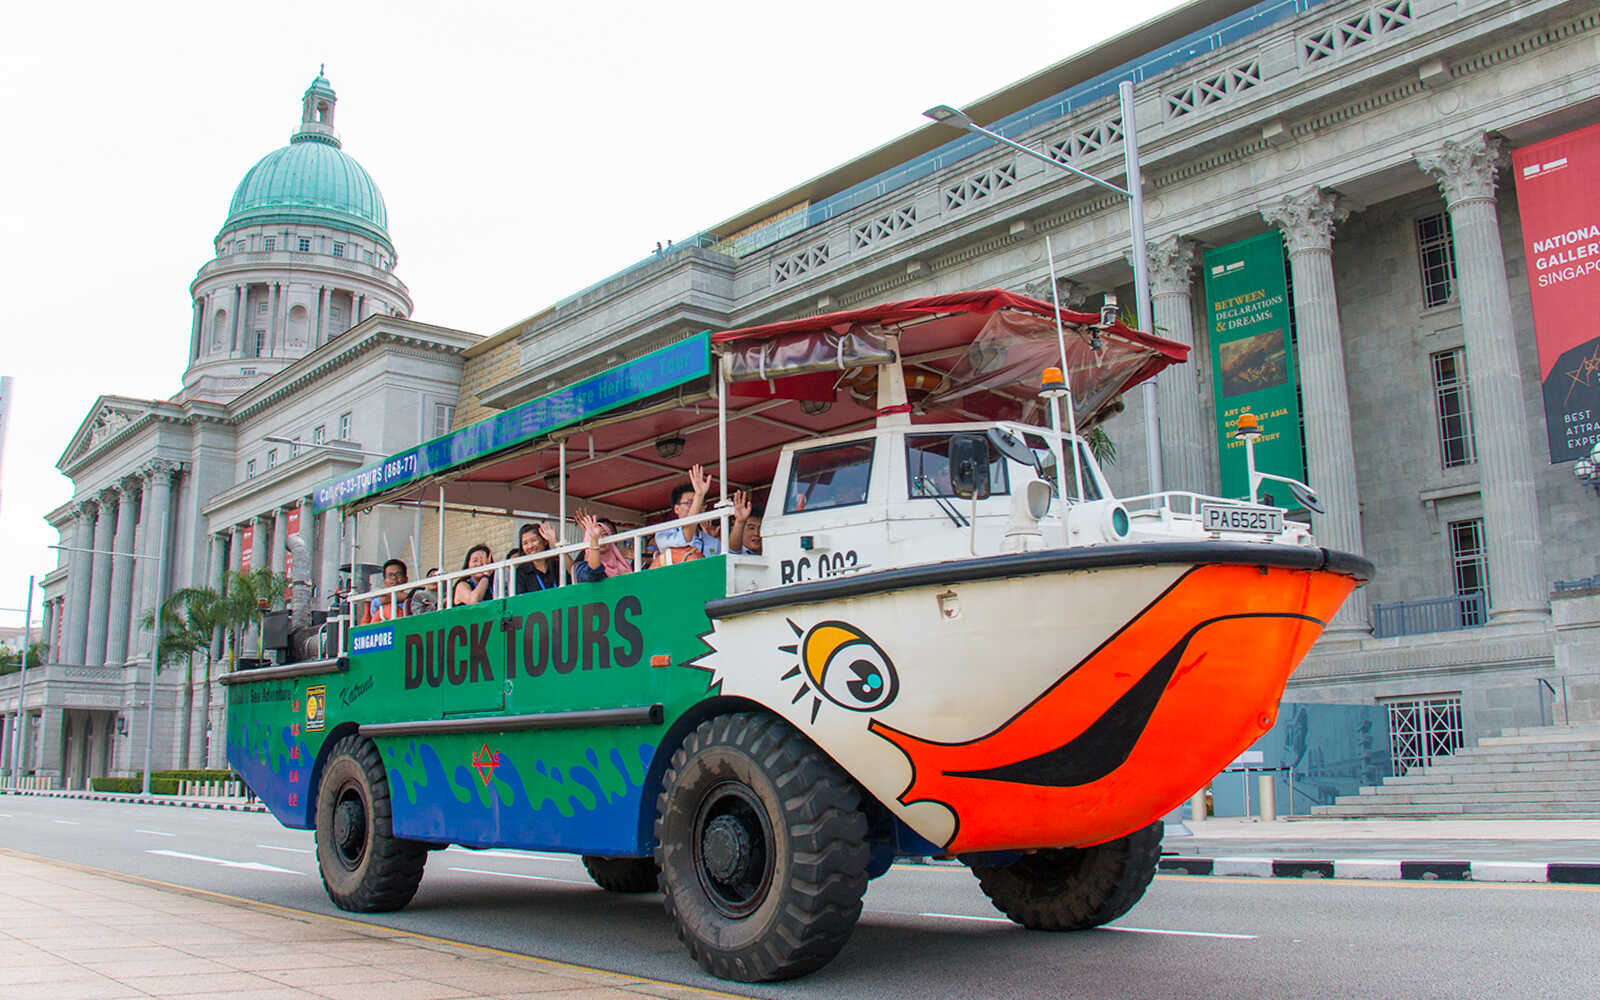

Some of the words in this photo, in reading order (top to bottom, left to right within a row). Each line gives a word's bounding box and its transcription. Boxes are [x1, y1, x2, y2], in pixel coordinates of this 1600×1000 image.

[1533, 225, 1600, 253] NATIONA
[1536, 241, 1600, 270] GALLER
[1214, 288, 1265, 311] BETWEEN
[1216, 295, 1283, 321] DECLARATIONS
[1216, 322, 1226, 332] &
[600, 370, 654, 396] Heritage
[659, 353, 690, 377] Tour
[1224, 408, 1239, 417] ART
[1240, 405, 1251, 413] OF
[1270, 408, 1288, 418] ASIA
[1564, 410, 1591, 423] BEST
[1250, 432, 1280, 445] ENTURY
[1209, 510, 1277, 530] PA6525T
[353, 631, 392, 650] SINGAPORE
[404, 620, 494, 690] DUCK
[500, 595, 644, 678] TOURS
